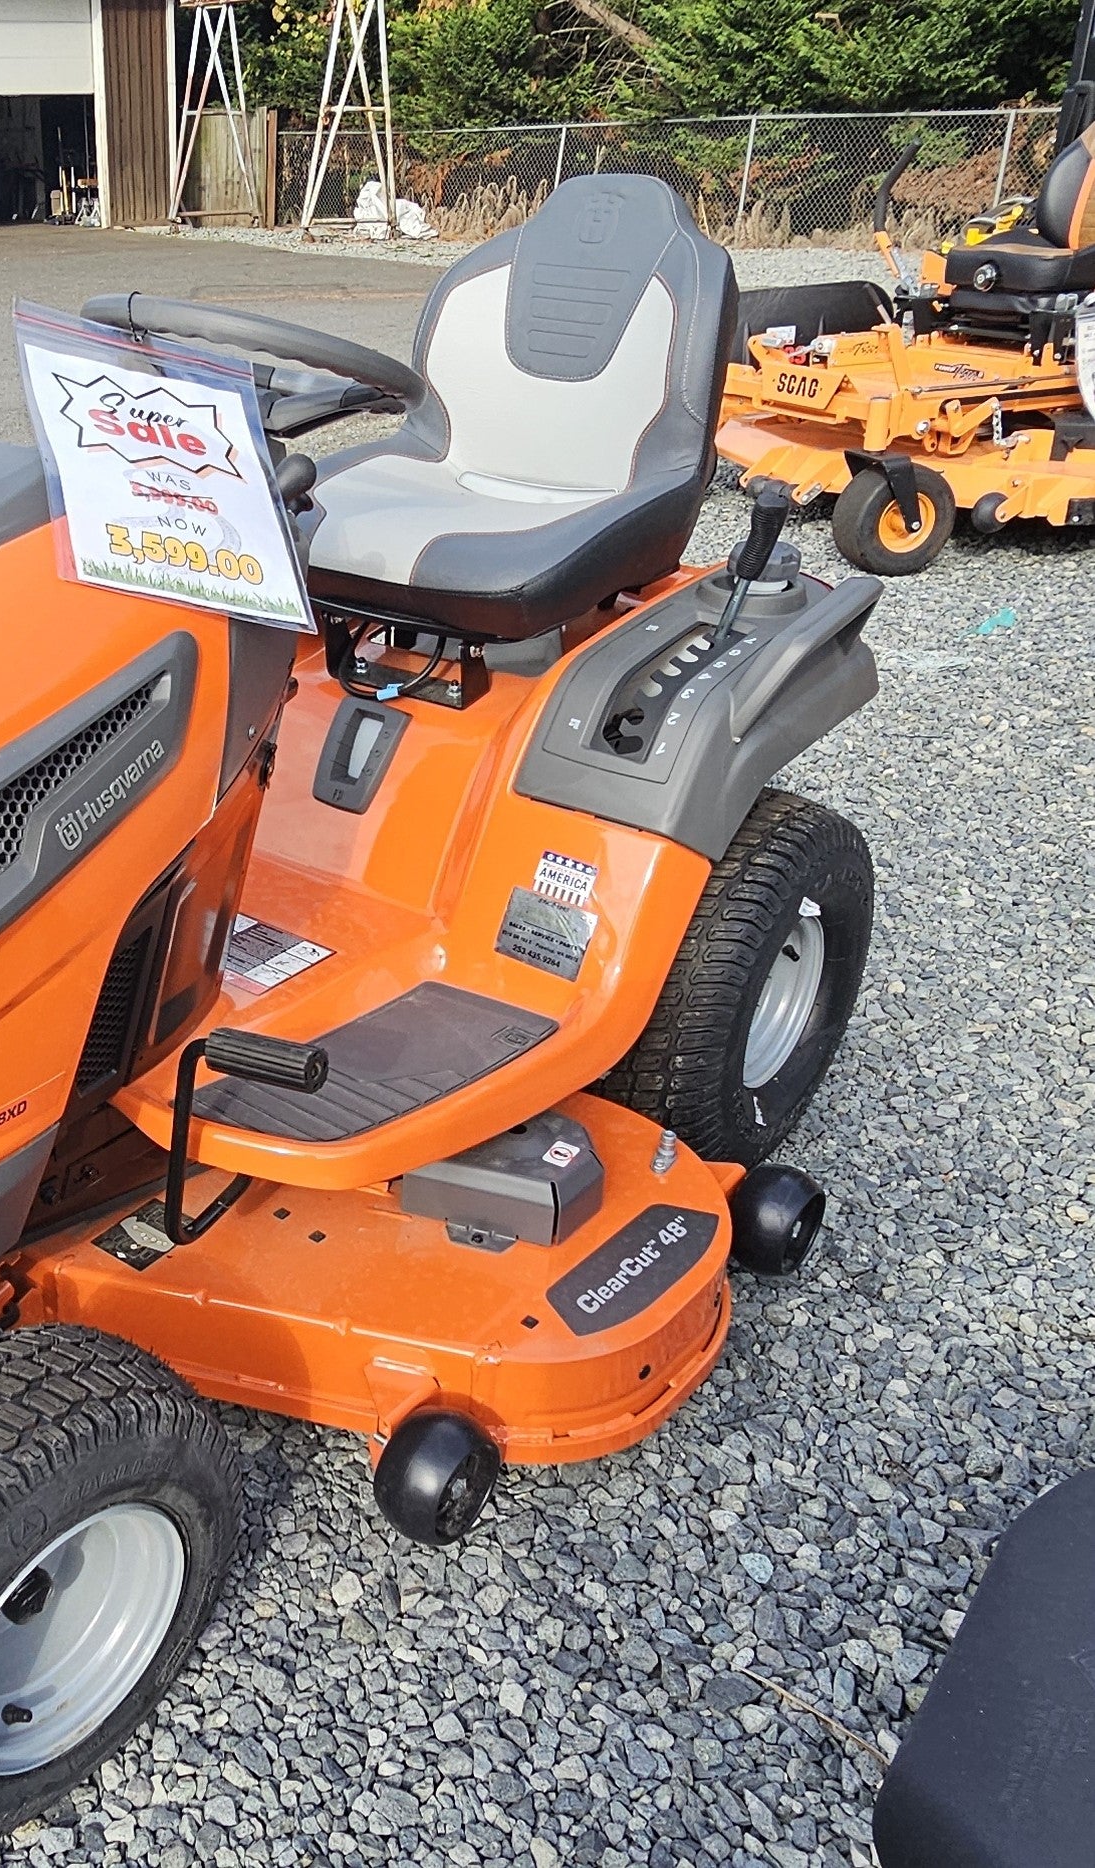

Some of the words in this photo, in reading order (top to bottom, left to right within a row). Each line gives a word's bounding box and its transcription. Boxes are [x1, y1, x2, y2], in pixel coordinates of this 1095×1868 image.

[777, 372, 819, 398] SCAG
[99, 392, 188, 428] Super
[88, 408, 207, 456] Sale
[145, 470, 191, 491] WAS
[157, 515, 206, 537] NOW
[105, 523, 264, 586] 3,599.00
[680, 688, 695, 700] 3
[667, 712, 681, 725] 2
[655, 742, 666, 755] 1
[75, 739, 165, 831] Husqvarna
[539, 867, 588, 892] AMERICA
[658, 1215, 688, 1246] 48"
